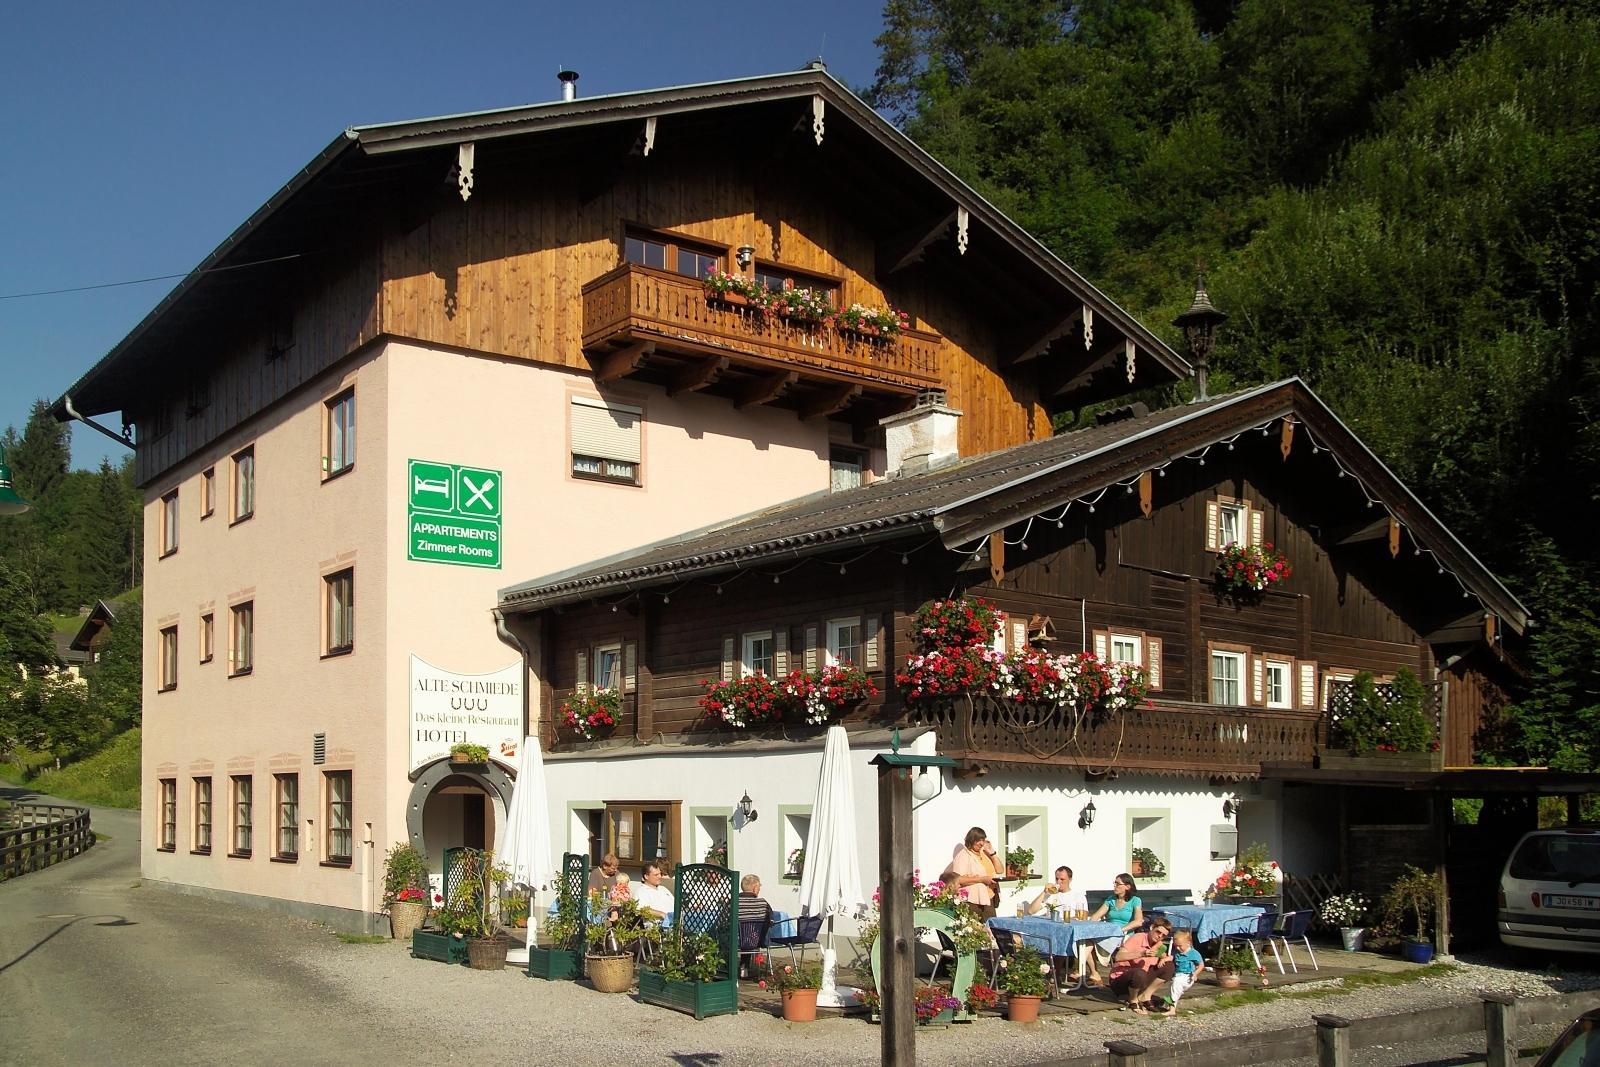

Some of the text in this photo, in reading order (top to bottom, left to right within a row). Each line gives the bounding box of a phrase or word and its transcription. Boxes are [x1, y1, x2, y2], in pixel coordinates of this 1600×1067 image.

[413, 522, 497, 541] APPARTEMENTS
[417, 540, 493, 558] Zimmer Rooms
[415, 678, 519, 696] ALTE SCHMIEDE
[415, 712, 519, 727] Das kleine Restaurant
[416, 729, 472, 743] HOTEL
